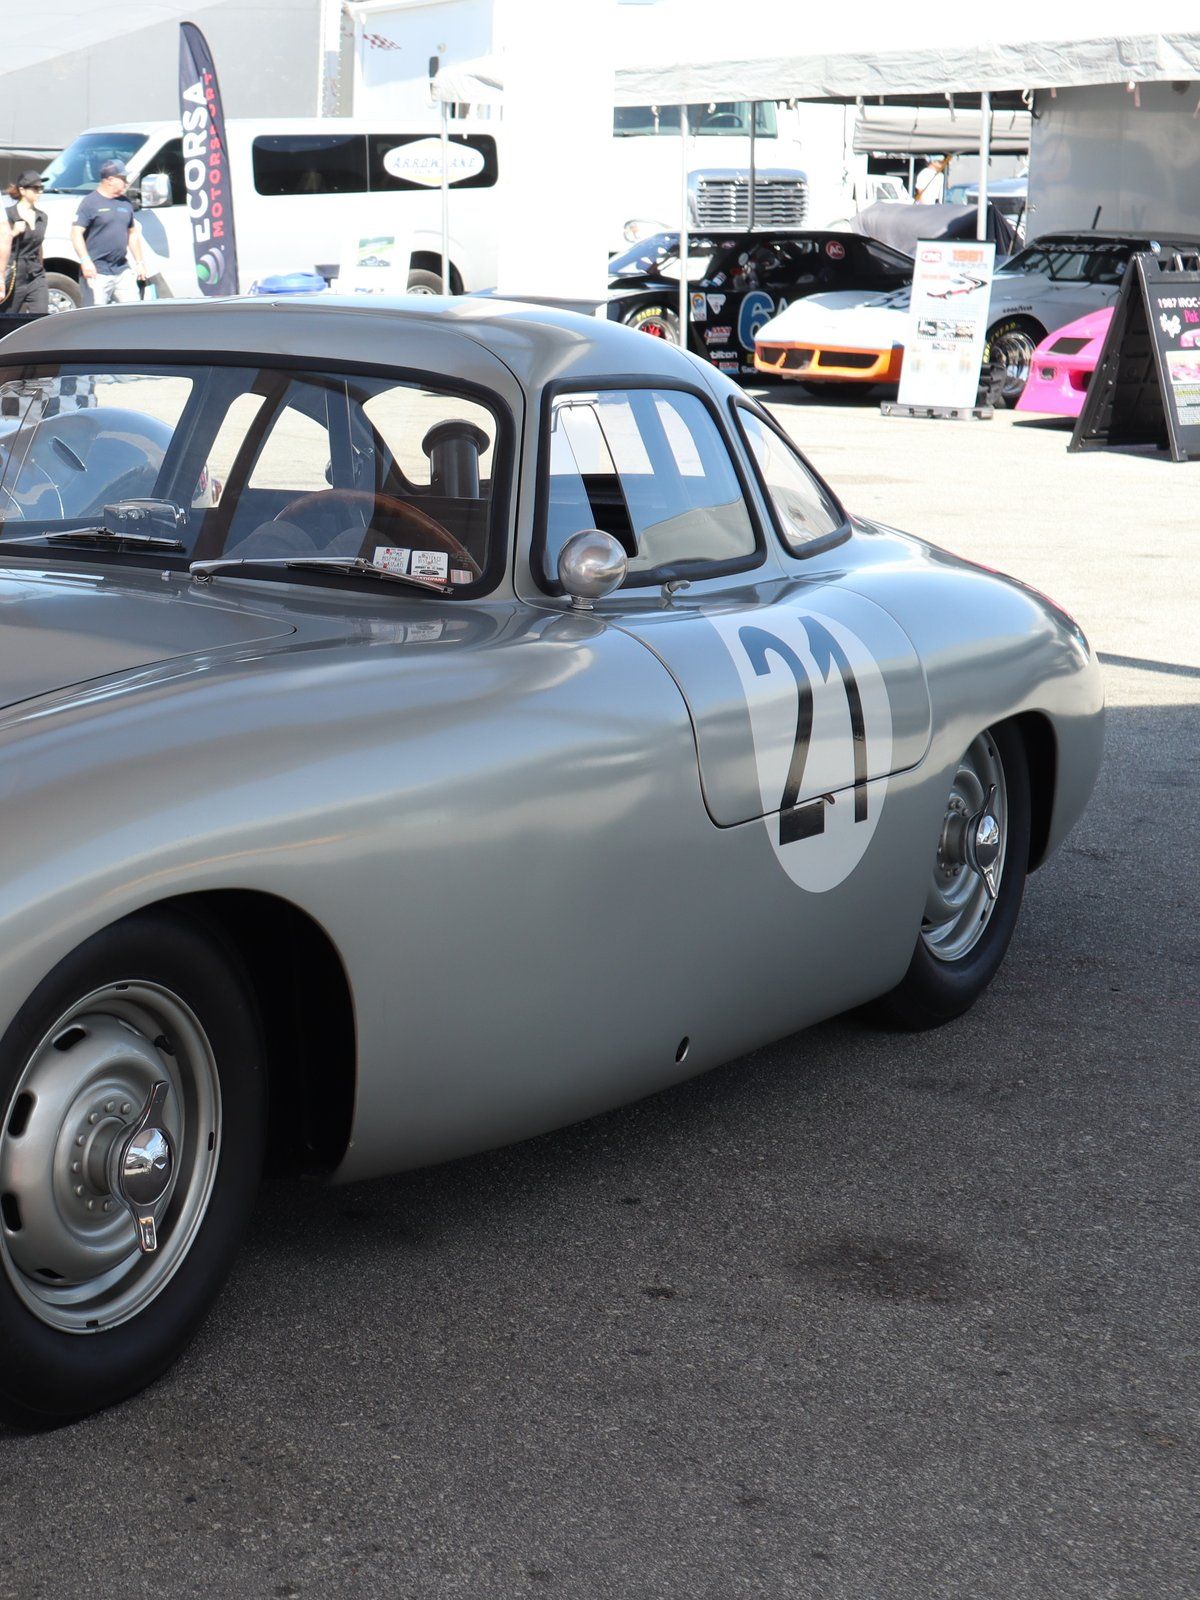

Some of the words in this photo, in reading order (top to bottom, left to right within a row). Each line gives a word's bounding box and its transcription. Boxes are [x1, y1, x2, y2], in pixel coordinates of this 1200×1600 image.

[182, 81, 211, 243] ECORSA
[392, 157, 476, 168] ARROWANE
[738, 291, 776, 352] 6
[1177, 296, 1200, 308] IROC-
[738, 616, 868, 846] 21
